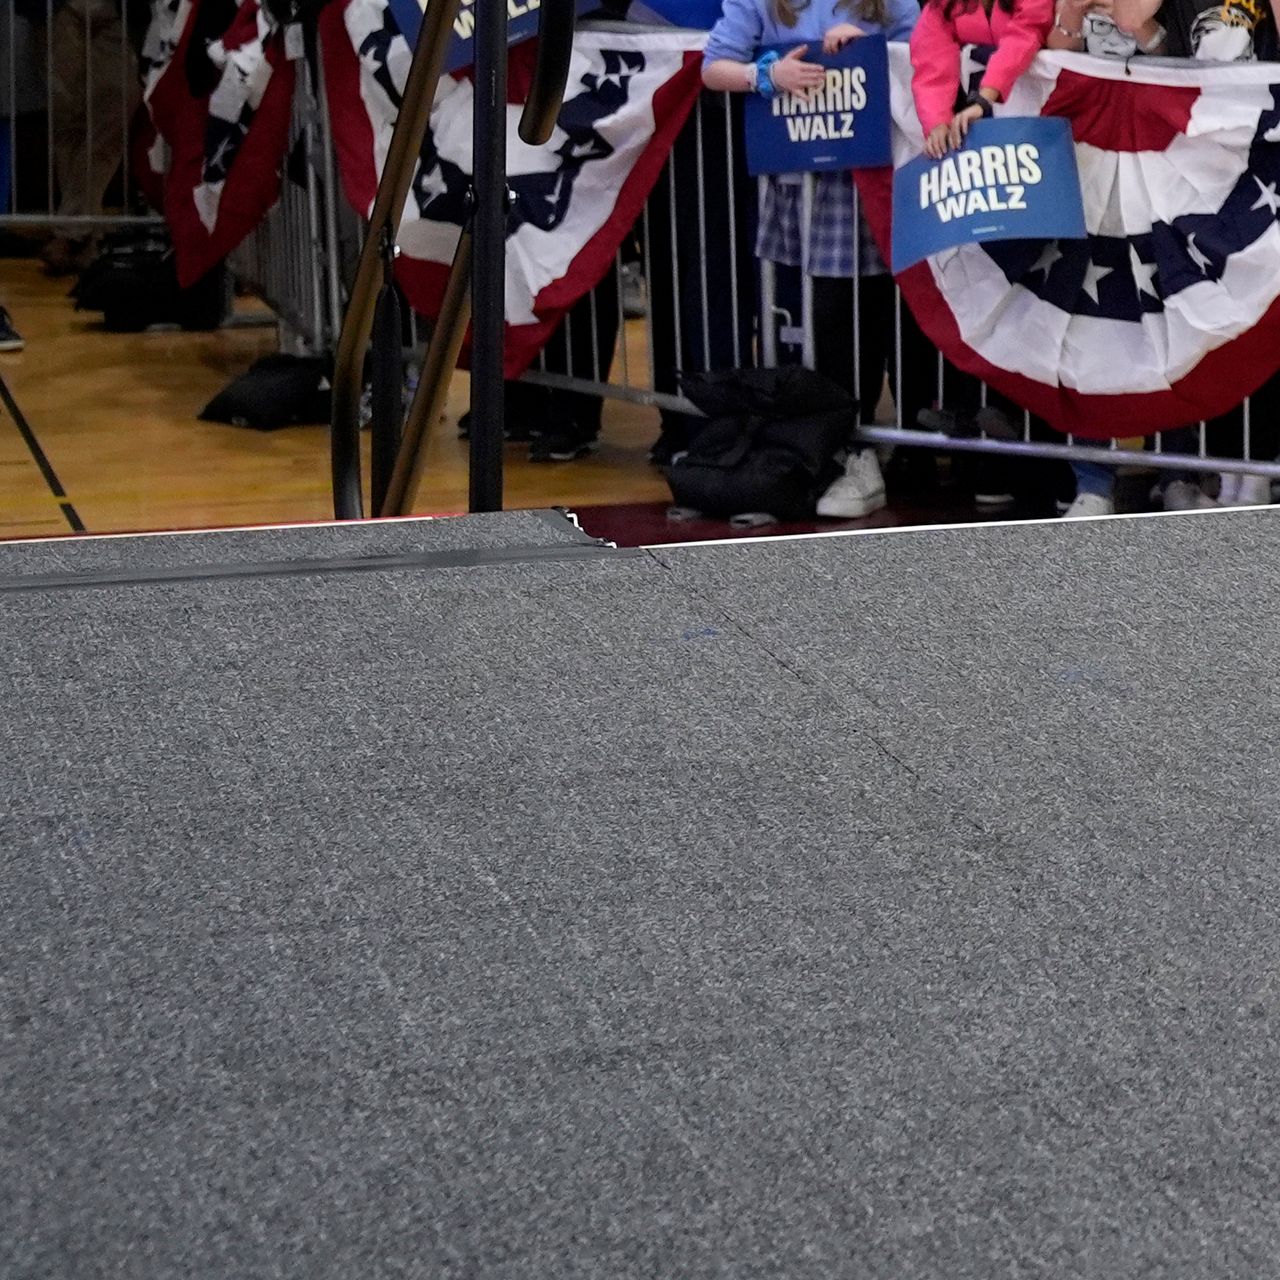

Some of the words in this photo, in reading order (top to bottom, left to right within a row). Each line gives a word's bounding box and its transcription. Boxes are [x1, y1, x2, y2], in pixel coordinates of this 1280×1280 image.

[786, 112, 855, 143] WALZ
[919, 142, 1043, 210] HARRIS
[934, 184, 1028, 224] WALZ
